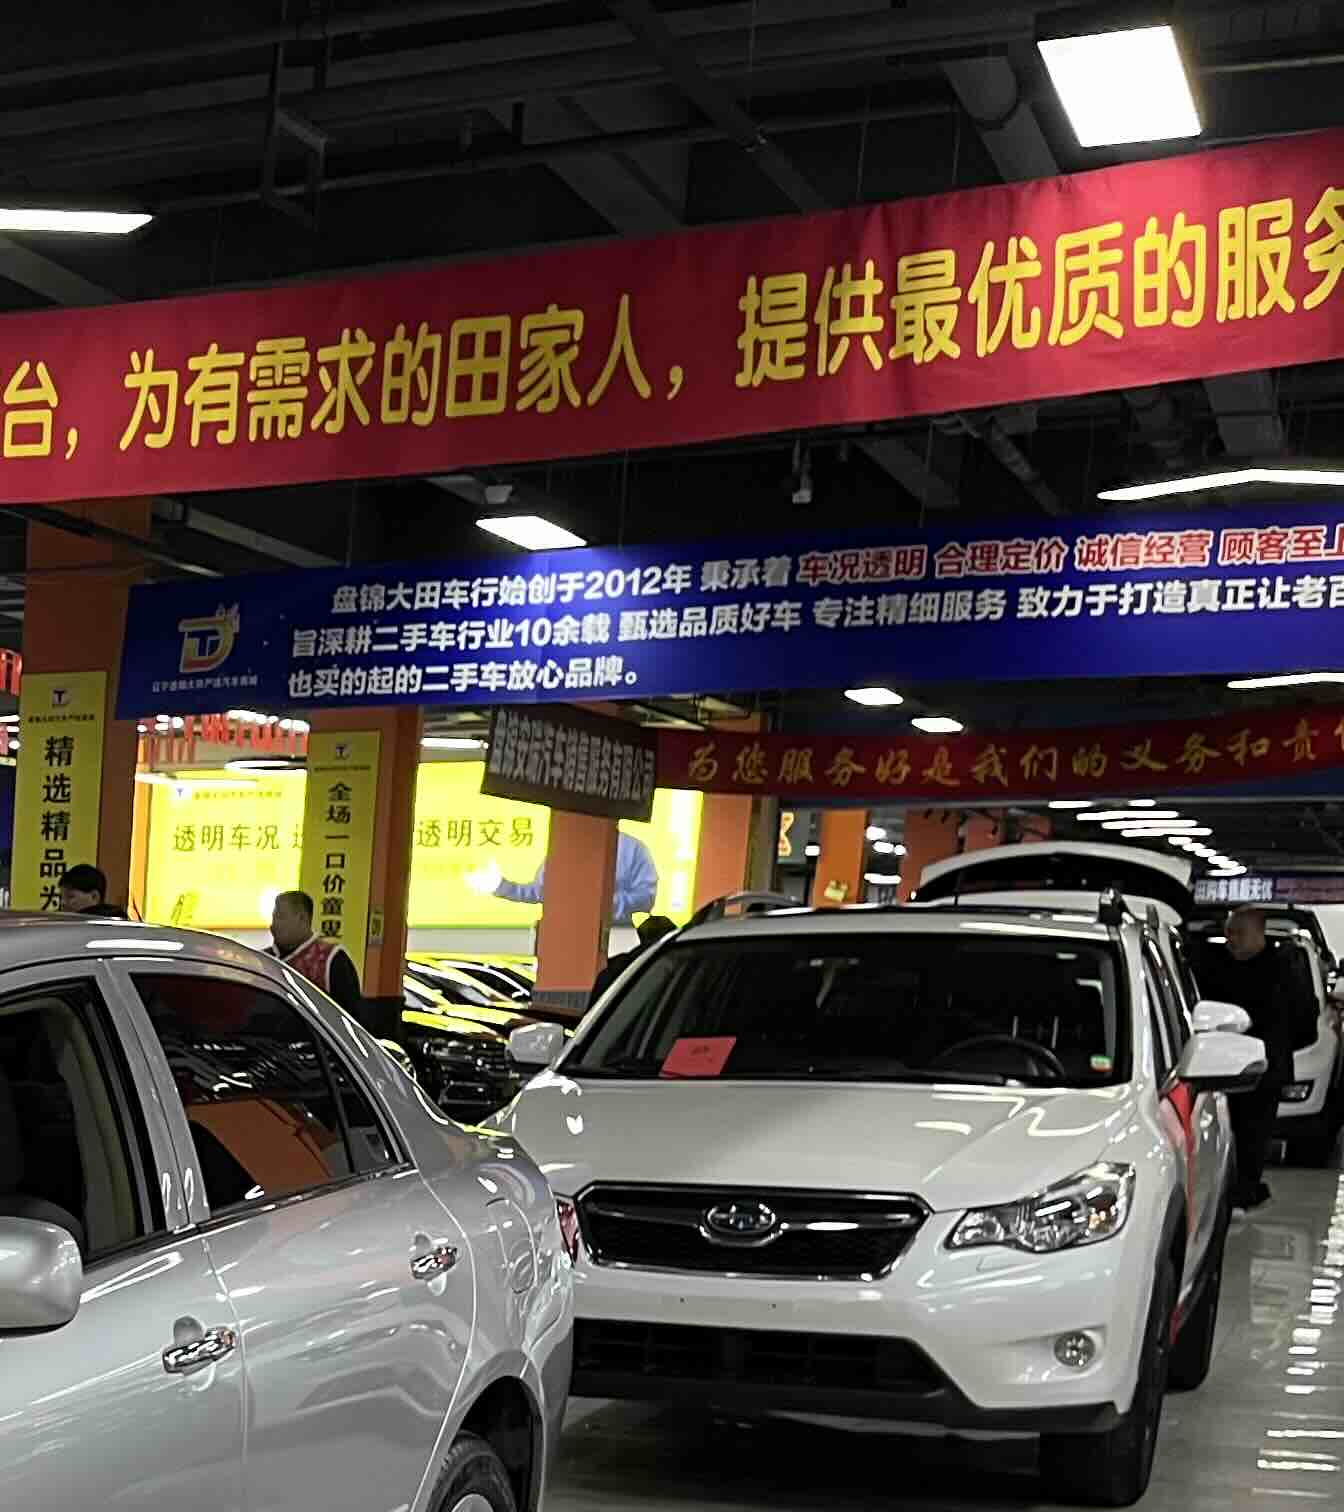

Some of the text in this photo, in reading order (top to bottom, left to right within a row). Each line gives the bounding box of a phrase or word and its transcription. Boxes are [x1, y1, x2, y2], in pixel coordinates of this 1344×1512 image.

[331, 563, 692, 613] 盘锦大田车行始创于2012年
[796, 544, 928, 587] 车况透明
[934, 537, 1068, 579] 合理定价
[1075, 530, 1213, 572] 诚信经营
[292, 611, 611, 657] 旨深耕二手车行业10余载
[617, 601, 802, 642] 甄选品质好车
[813, 588, 1007, 628] 专注精细服务
[288, 655, 638, 698] 也买的起的二手车放心品牌。
[687, 717, 1344, 788] 为您服务好是我们的义务和责
[415, 816, 535, 848] 透明交易
